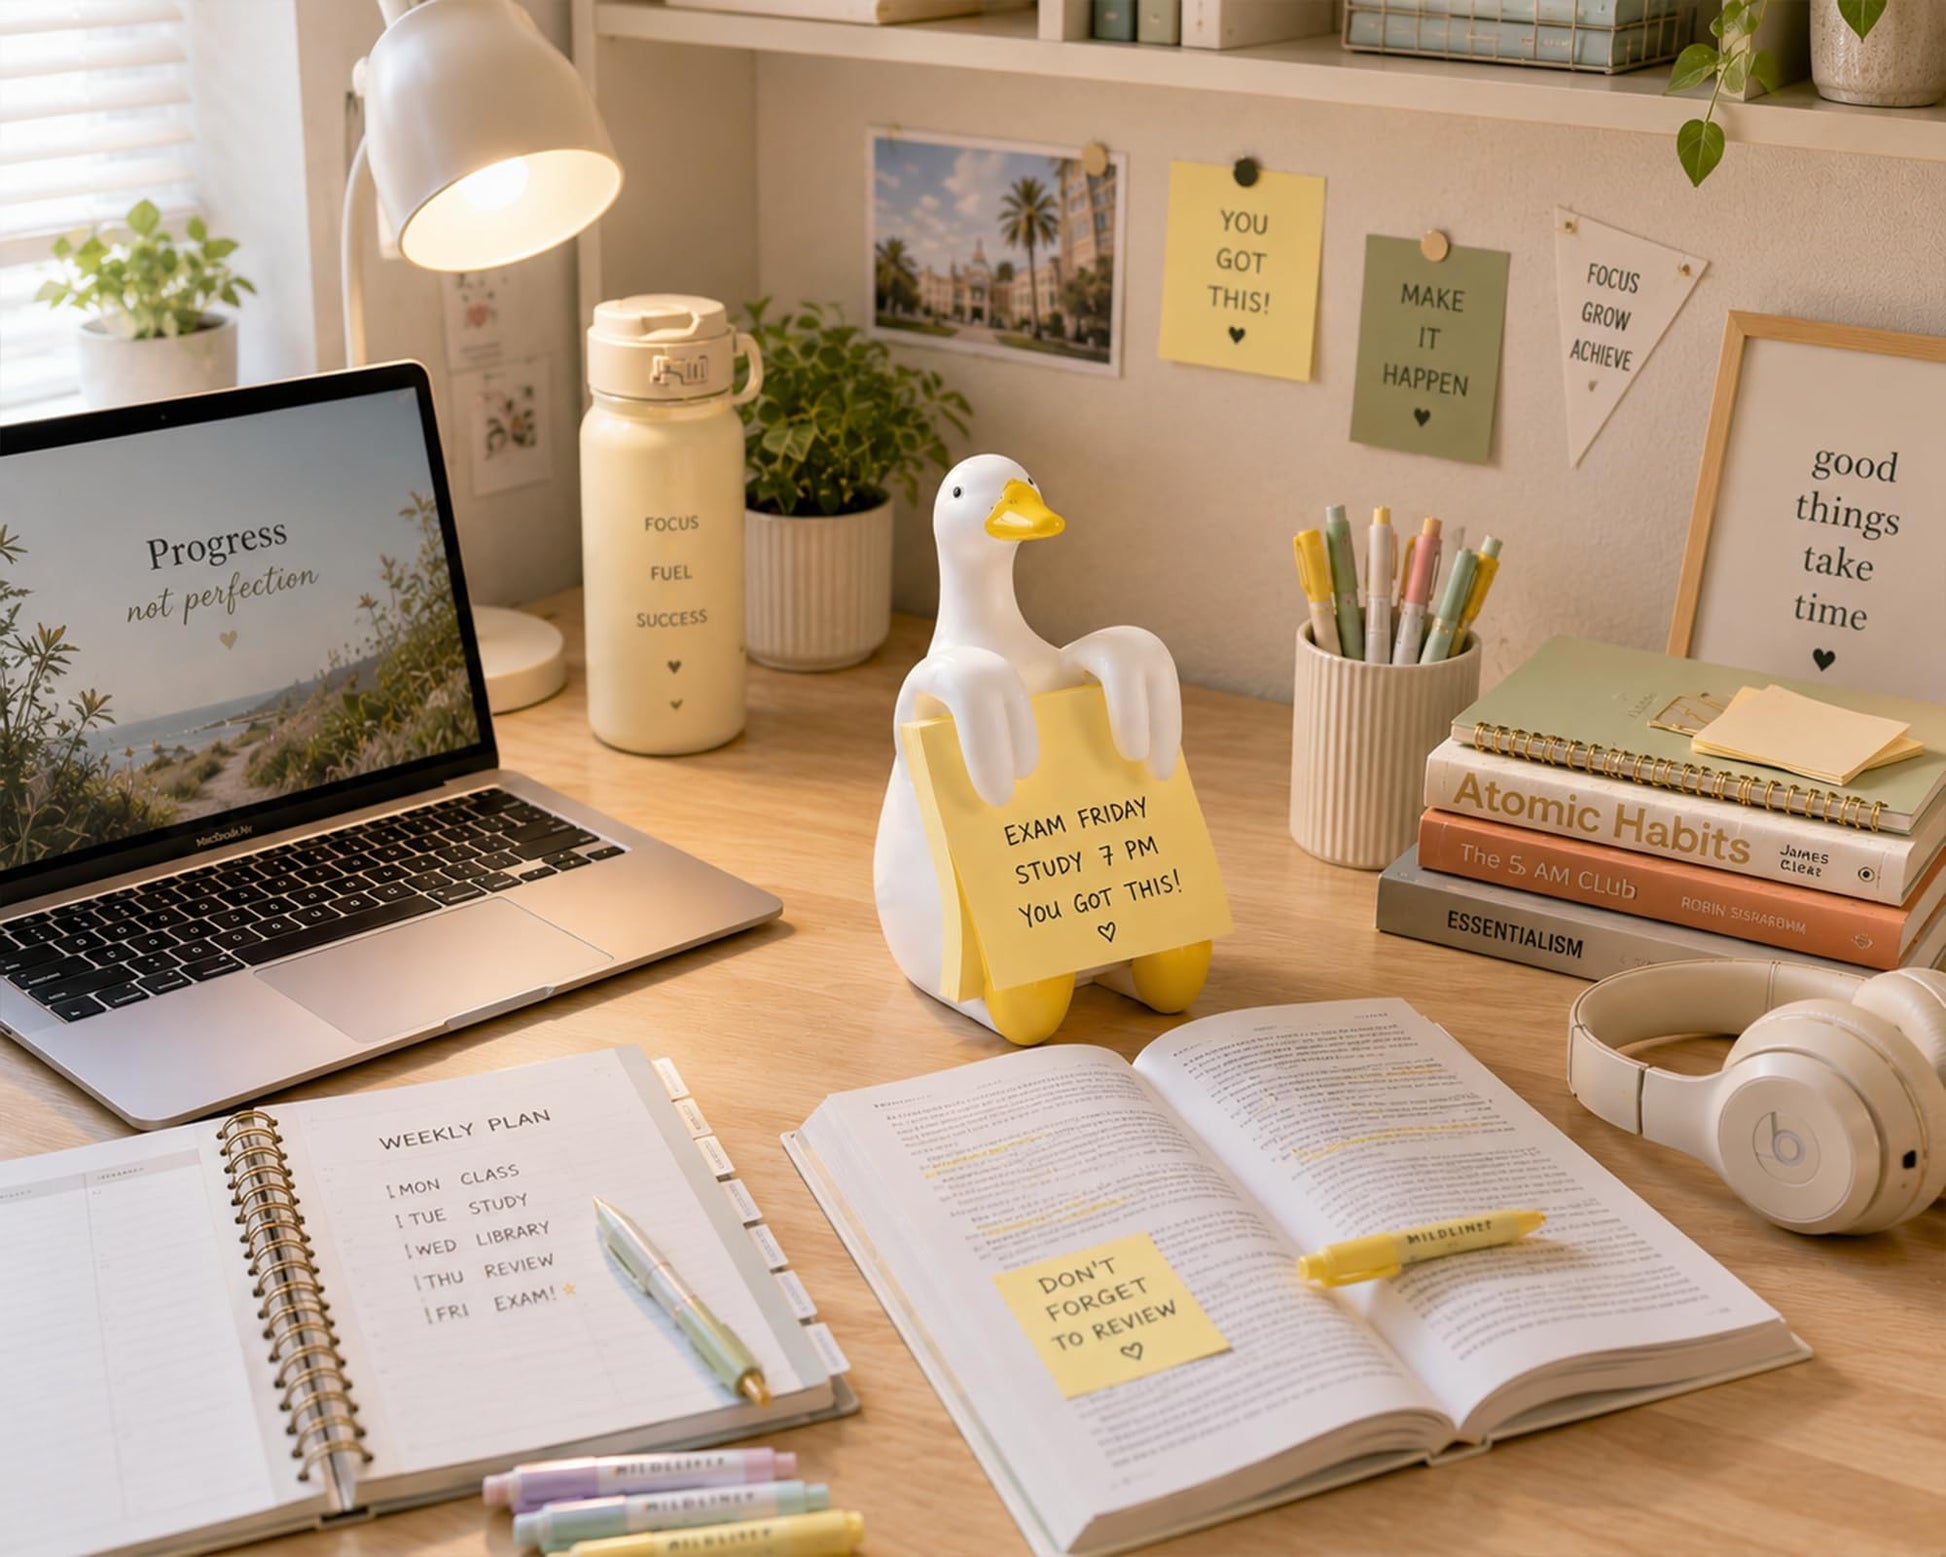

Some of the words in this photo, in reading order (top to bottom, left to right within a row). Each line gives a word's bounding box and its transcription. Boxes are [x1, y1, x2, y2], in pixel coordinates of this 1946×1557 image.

[1220, 208, 1268, 235] YOU
[1216, 247, 1267, 274] GOT
[1587, 263, 1640, 293] FOCUS
[1207, 285, 1270, 315] THIS!
[1401, 283, 1466, 312] MAKE
[1582, 301, 1631, 331] GROW
[1419, 327, 1442, 350] IT
[1569, 339, 1633, 372] ACHIEVE
[1383, 363, 1469, 397] HAPPEN
[1811, 450, 1898, 483] good
[644, 515, 699, 531] FOCUS
[1796, 491, 1900, 541] things
[146, 523, 288, 570] Progress
[651, 565, 693, 581] FUEL
[1804, 546, 1874, 582] take
[127, 588, 173, 622] not
[183, 566, 320, 625] perfection
[1794, 593, 1868, 631] time
[636, 609, 708, 628] SUCCESS
[1004, 815, 1067, 846] EXAM
[1077, 796, 1147, 829] FRIDAY
[1453, 772, 1601, 833] Atomic
[1614, 803, 1750, 865] Habits
[1015, 851, 1082, 885] STUDY
[1098, 845, 1113, 866] 7
[1125, 836, 1159, 860] PM
[1461, 843, 1500, 869] The
[1534, 862, 1569, 886] AM
[1123, 868, 1182, 901] THIS!
[1681, 896, 1726, 916] ROBIN
[1448, 910, 1583, 958] ESSENTIALISM
[379, 1122, 473, 1150] WEEKLY
[488, 1109, 551, 1132] PLAN
[460, 1164, 520, 1186] CLASS
[409, 1208, 447, 1226] TUE
[468, 1193, 528, 1215] STUDY
[476, 1221, 550, 1247] LIBRARY
[484, 1253, 554, 1279] REVIEW
[1038, 1257, 1115, 1294] DON'T
[494, 1286, 557, 1312] EXAM!
[1046, 1277, 1147, 1322] FORGET
[1052, 1332, 1084, 1351] TO
[1092, 1299, 1176, 1340] REVIEW
